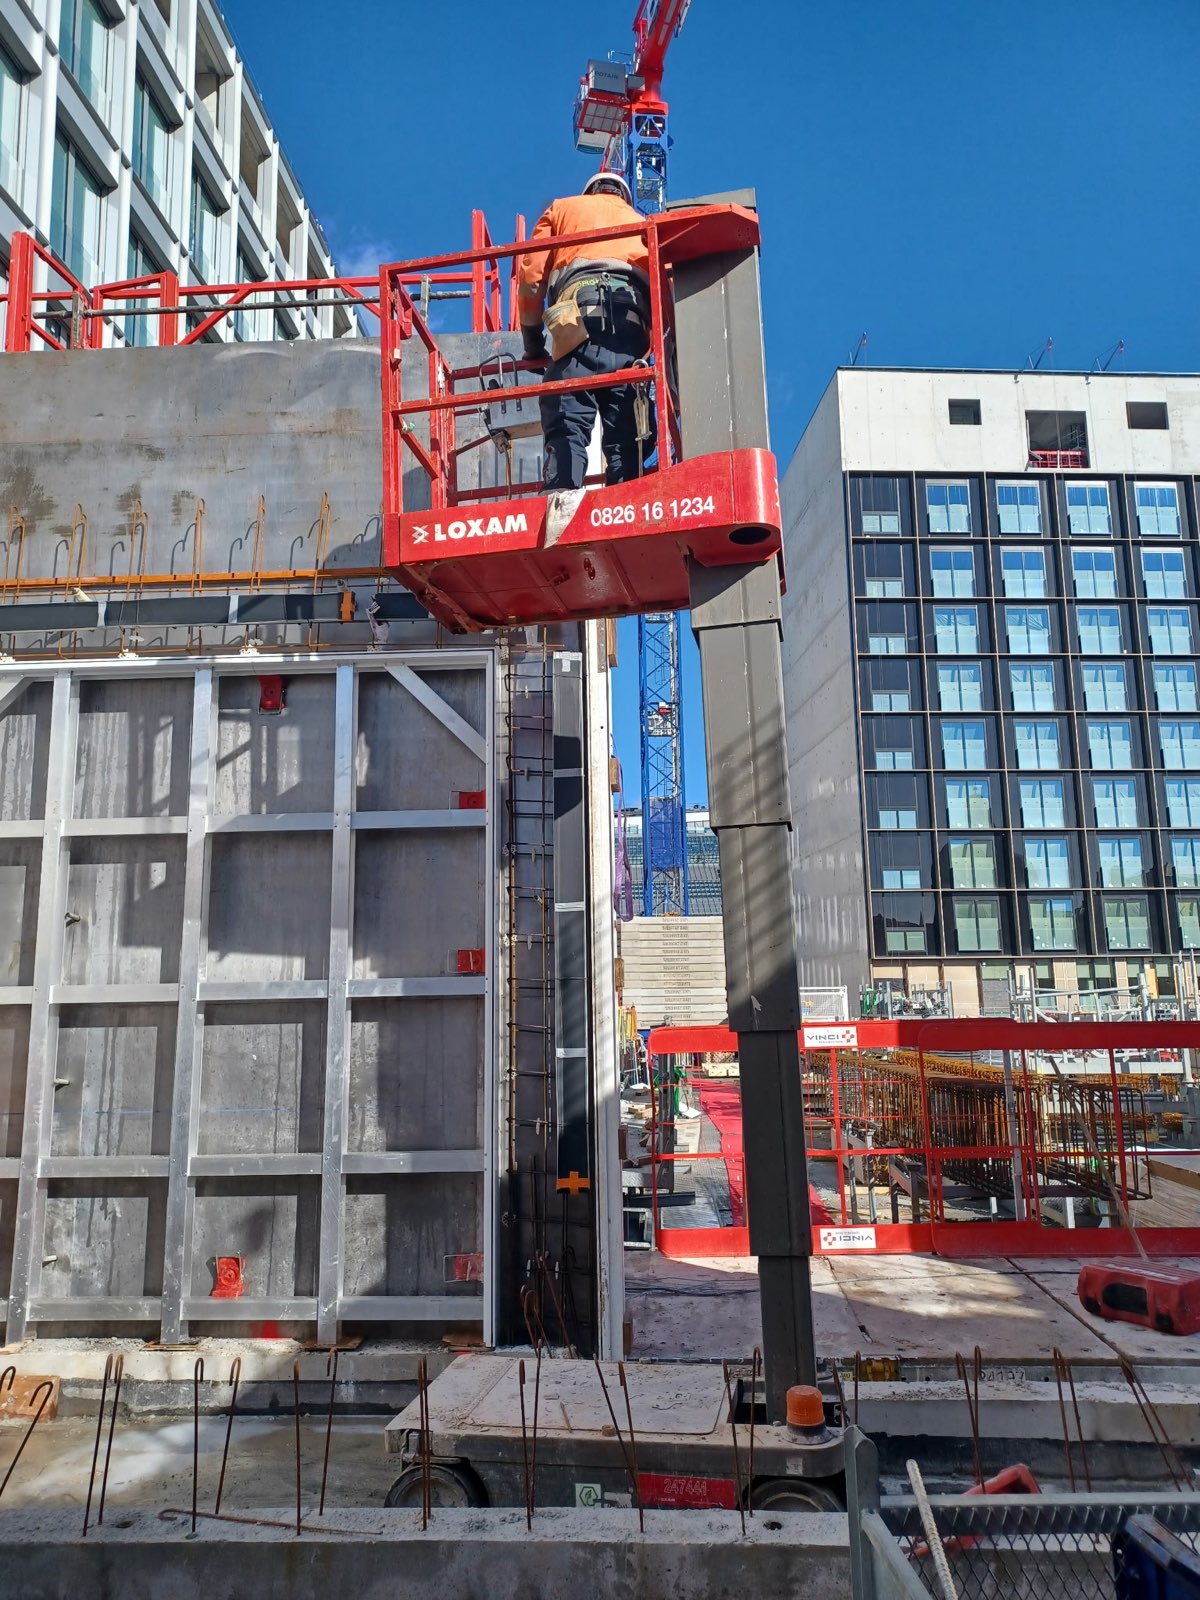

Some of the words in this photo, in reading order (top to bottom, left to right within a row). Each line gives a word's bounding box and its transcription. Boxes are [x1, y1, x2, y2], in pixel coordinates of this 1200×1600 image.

[590, 504, 635, 527] 0826
[641, 501, 664, 521] 16
[669, 495, 716, 518] 1234
[434, 513, 528, 541] LOXAM
[663, 1478, 708, 1497] 247441
